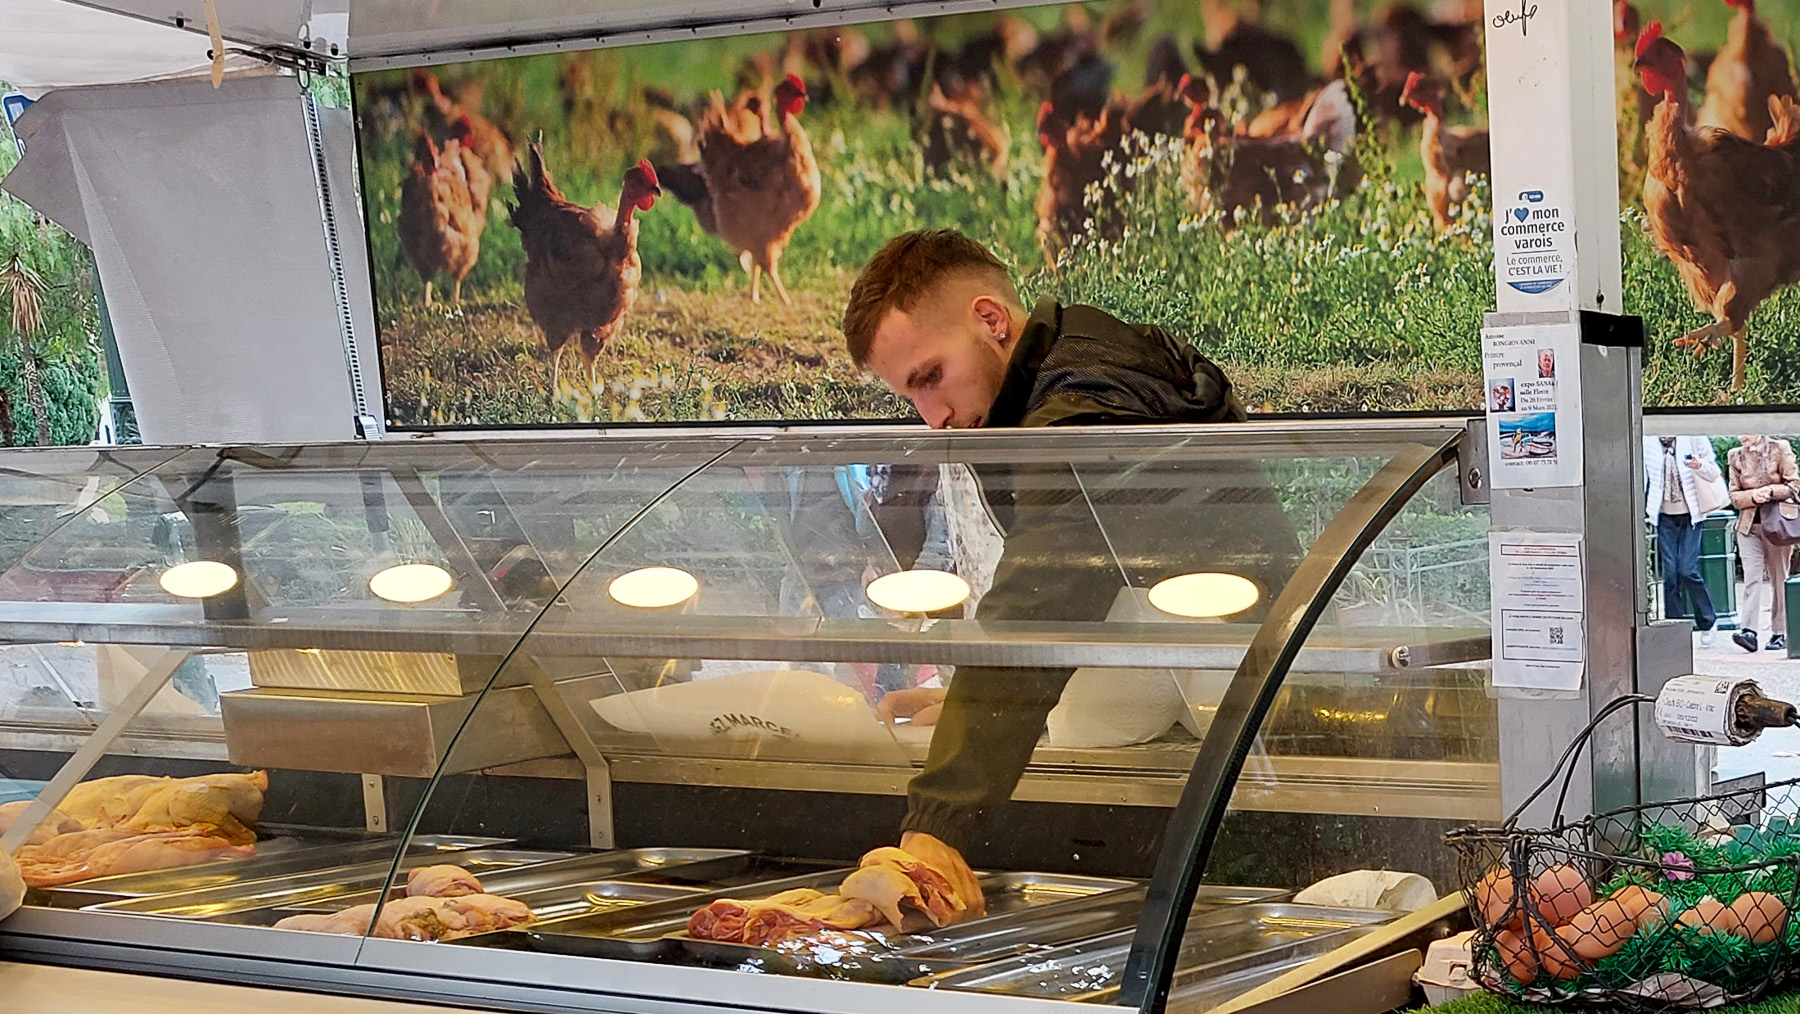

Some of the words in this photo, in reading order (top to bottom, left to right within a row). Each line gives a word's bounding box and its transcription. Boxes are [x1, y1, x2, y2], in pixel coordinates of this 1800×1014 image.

[1532, 208, 1559, 220] mon
[1501, 221, 1565, 236] commerce
[1514, 233, 1553, 249] varois
[1506, 256, 1516, 265] Le
[1508, 266, 1531, 276] C'EST
[1532, 265, 1543, 274] LA
[1544, 264, 1558, 274] VIE
[1493, 359, 1522, 370] provençal
